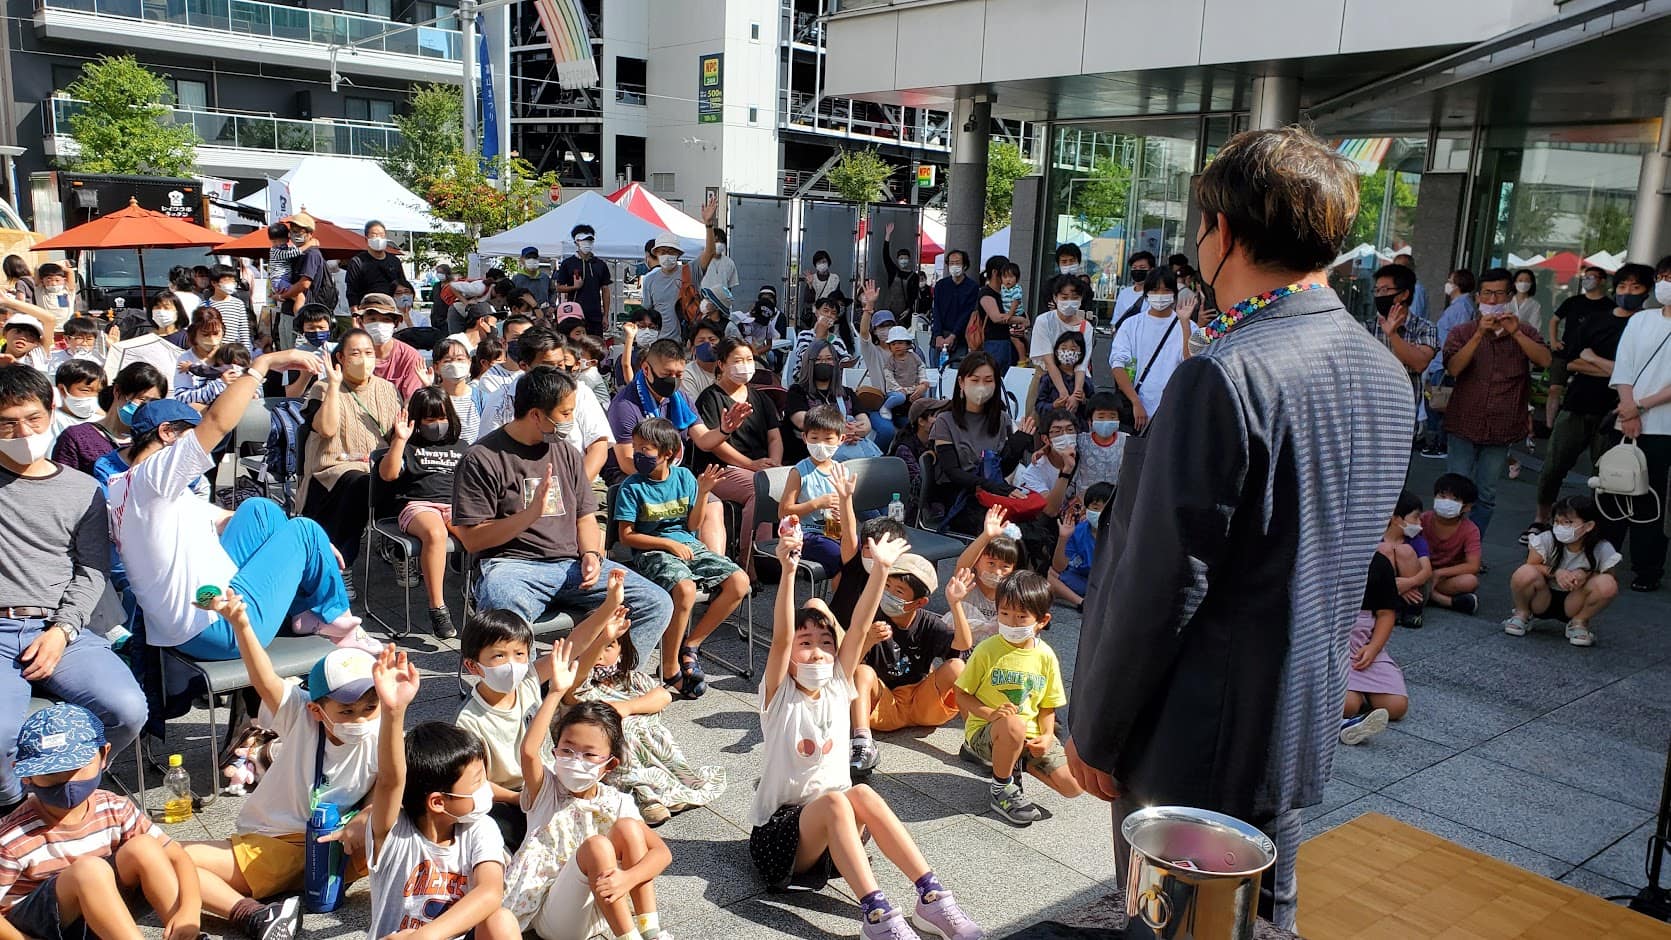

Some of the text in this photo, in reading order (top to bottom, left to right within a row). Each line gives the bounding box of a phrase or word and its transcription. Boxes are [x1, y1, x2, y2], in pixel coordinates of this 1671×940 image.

[705, 61, 717, 73] NPC
[919, 167, 931, 177] NPC
[414, 448, 462, 460] Always be
[991, 668, 1024, 686] SKATE
